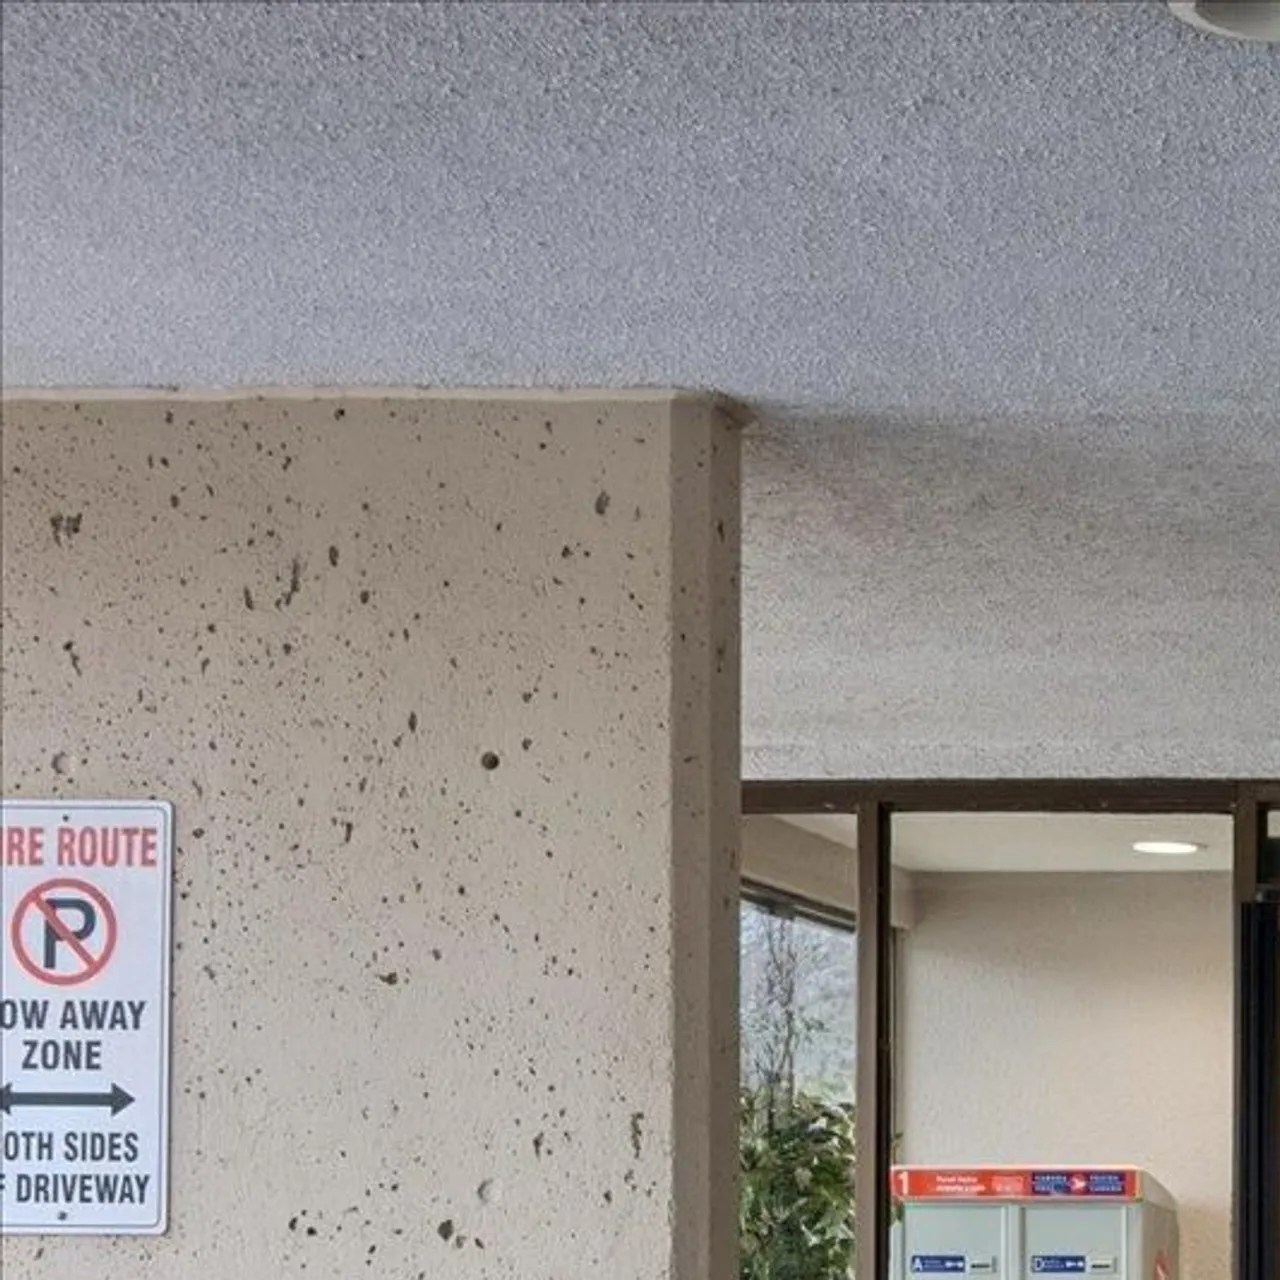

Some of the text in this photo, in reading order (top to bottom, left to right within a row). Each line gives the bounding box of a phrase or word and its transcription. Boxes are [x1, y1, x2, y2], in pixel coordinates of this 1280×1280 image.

[57, 826, 158, 867] ROUTE
[60, 1000, 147, 1031] AWAY
[22, 1040, 102, 1070] ZONE
[64, 1131, 139, 1162] SIDES
[16, 1174, 151, 1205] DRIVEWAY
[898, 1171, 909, 1195] 1
